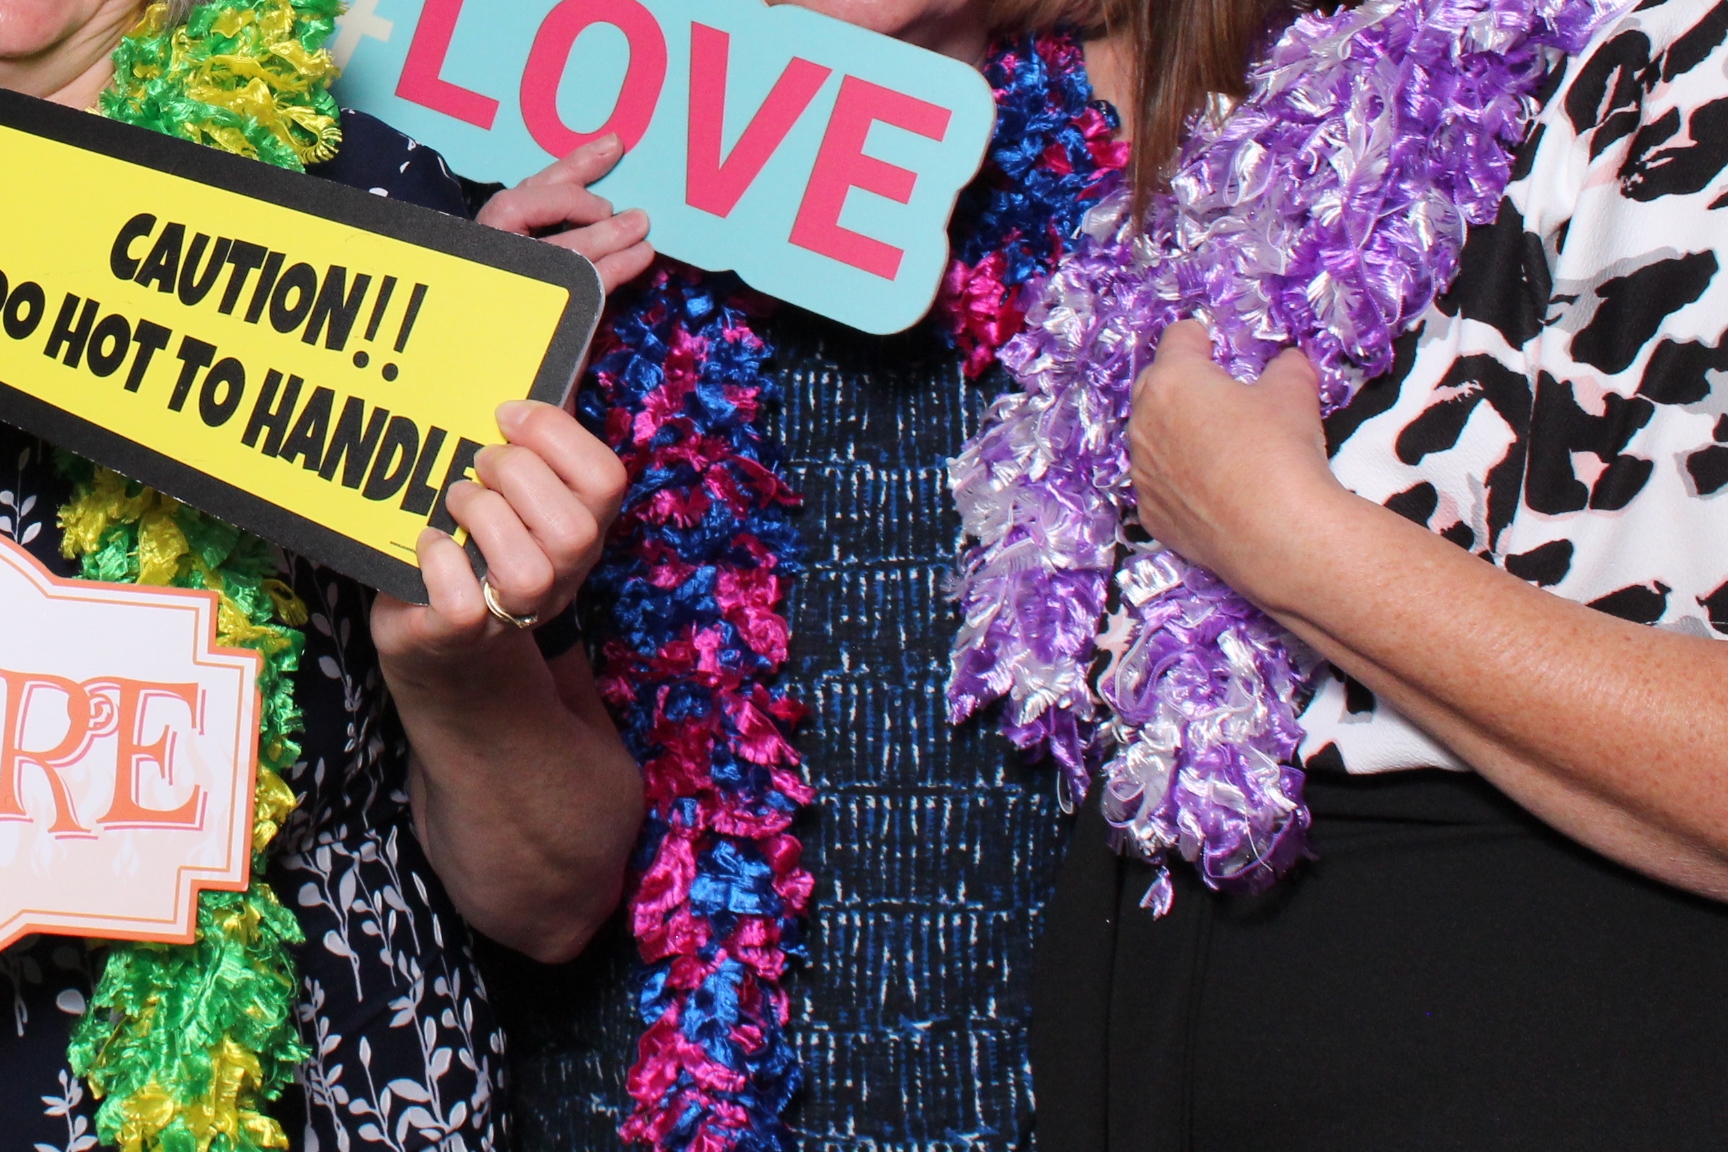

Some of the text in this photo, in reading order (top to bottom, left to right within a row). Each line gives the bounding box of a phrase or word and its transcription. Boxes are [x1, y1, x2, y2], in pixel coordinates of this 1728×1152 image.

[45, 293, 172, 394] HOT
[167, 335, 246, 429] TO
[109, 213, 429, 382] CAUTION!!
